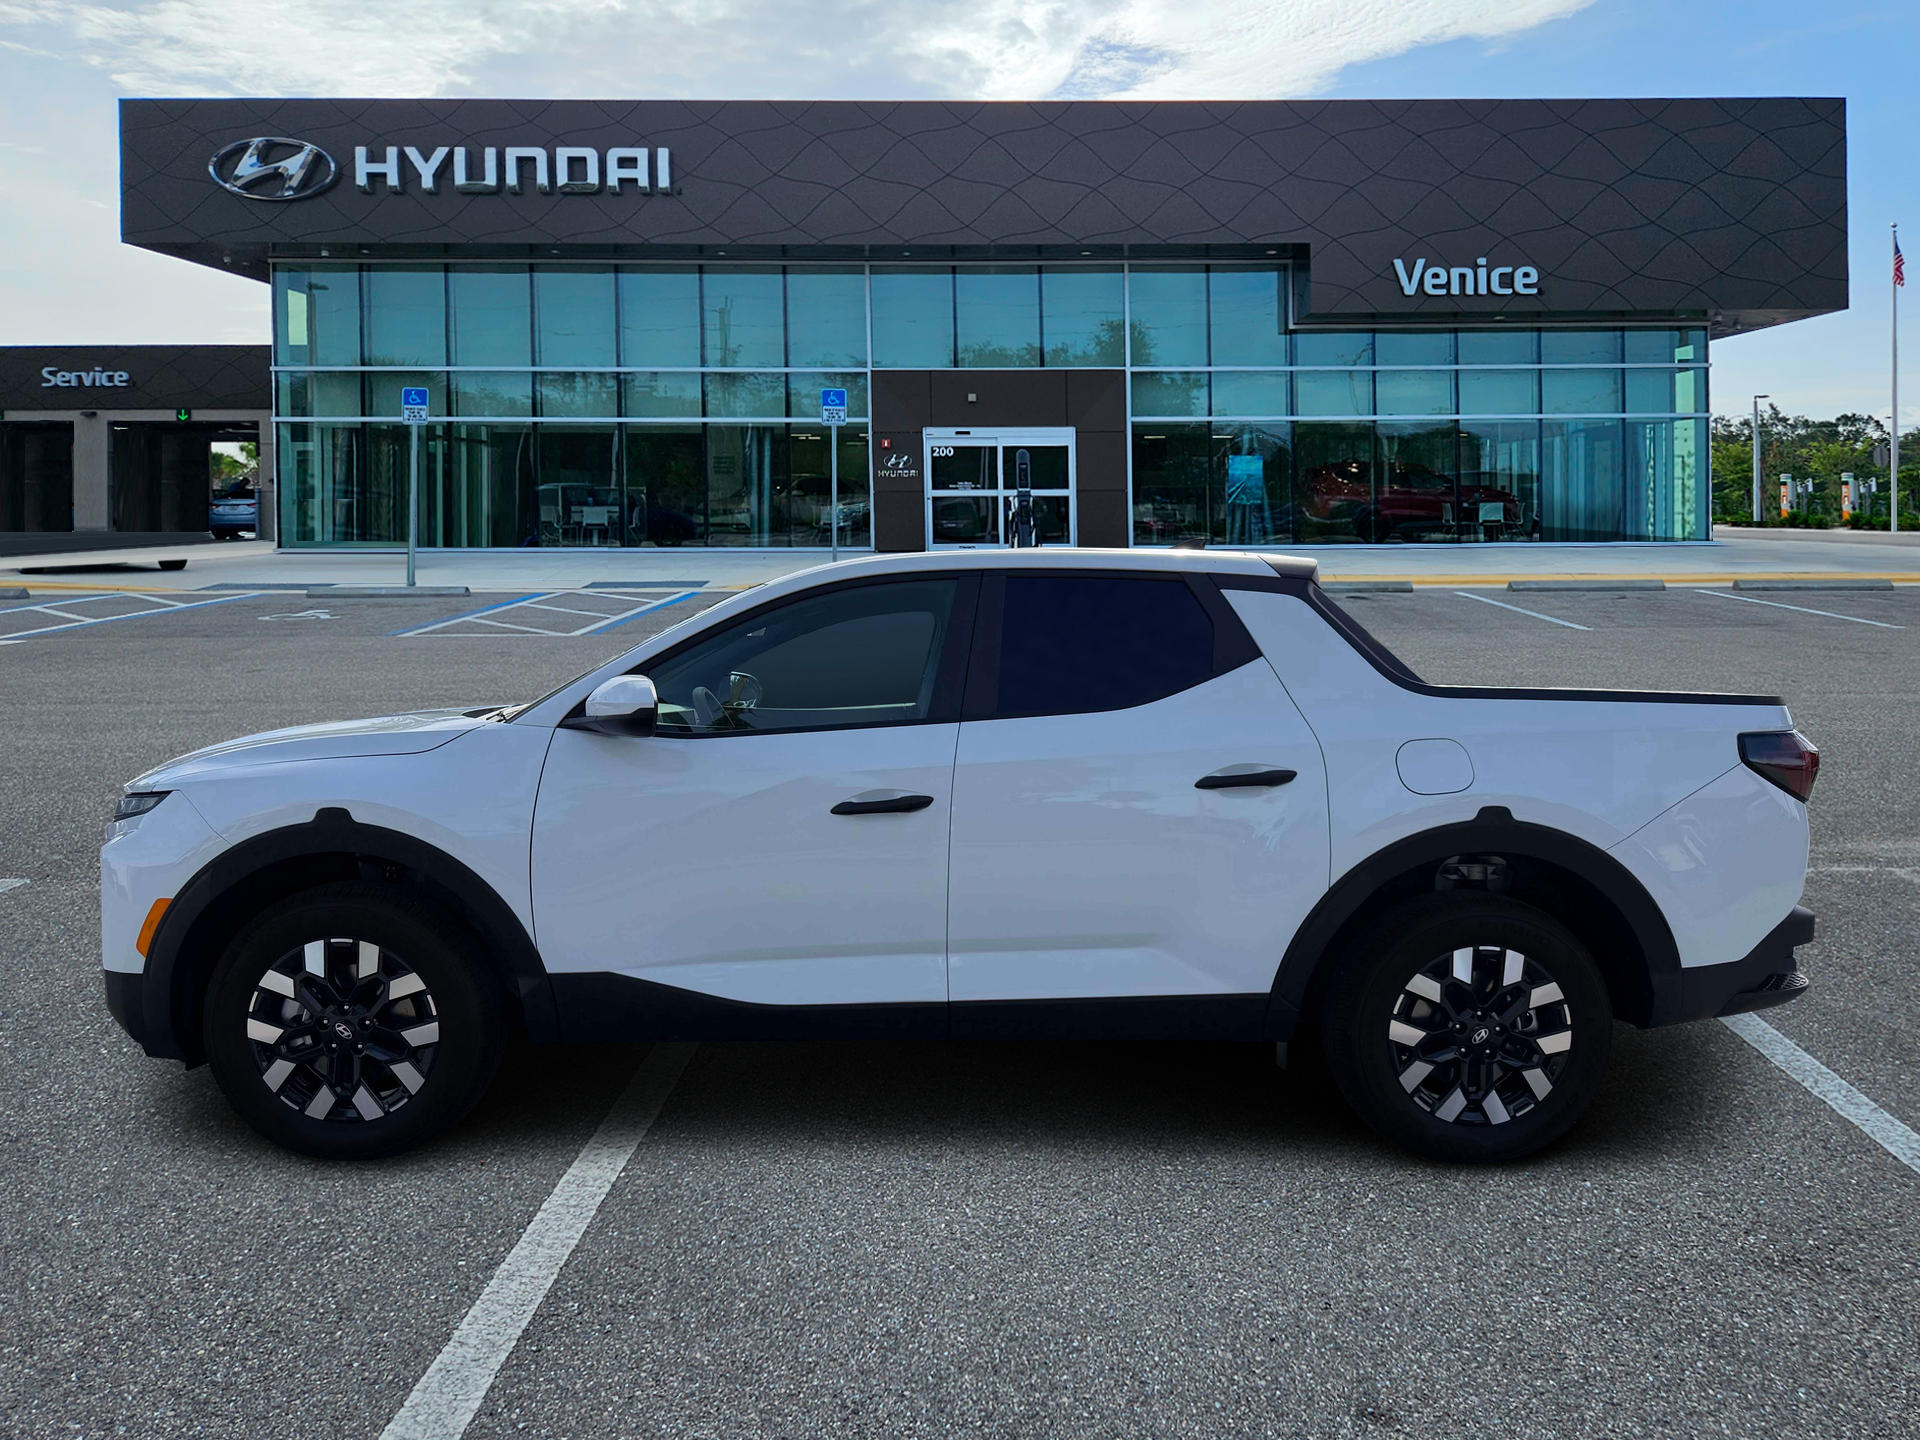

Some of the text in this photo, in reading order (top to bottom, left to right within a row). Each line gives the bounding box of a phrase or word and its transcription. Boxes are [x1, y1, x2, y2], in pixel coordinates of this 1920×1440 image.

[354, 146, 670, 194] HYUNDAI
[1393, 257, 1539, 296] Venice
[41, 366, 130, 387] Service
[932, 446, 954, 457] 200
[877, 469, 919, 478] HYUNDAI
